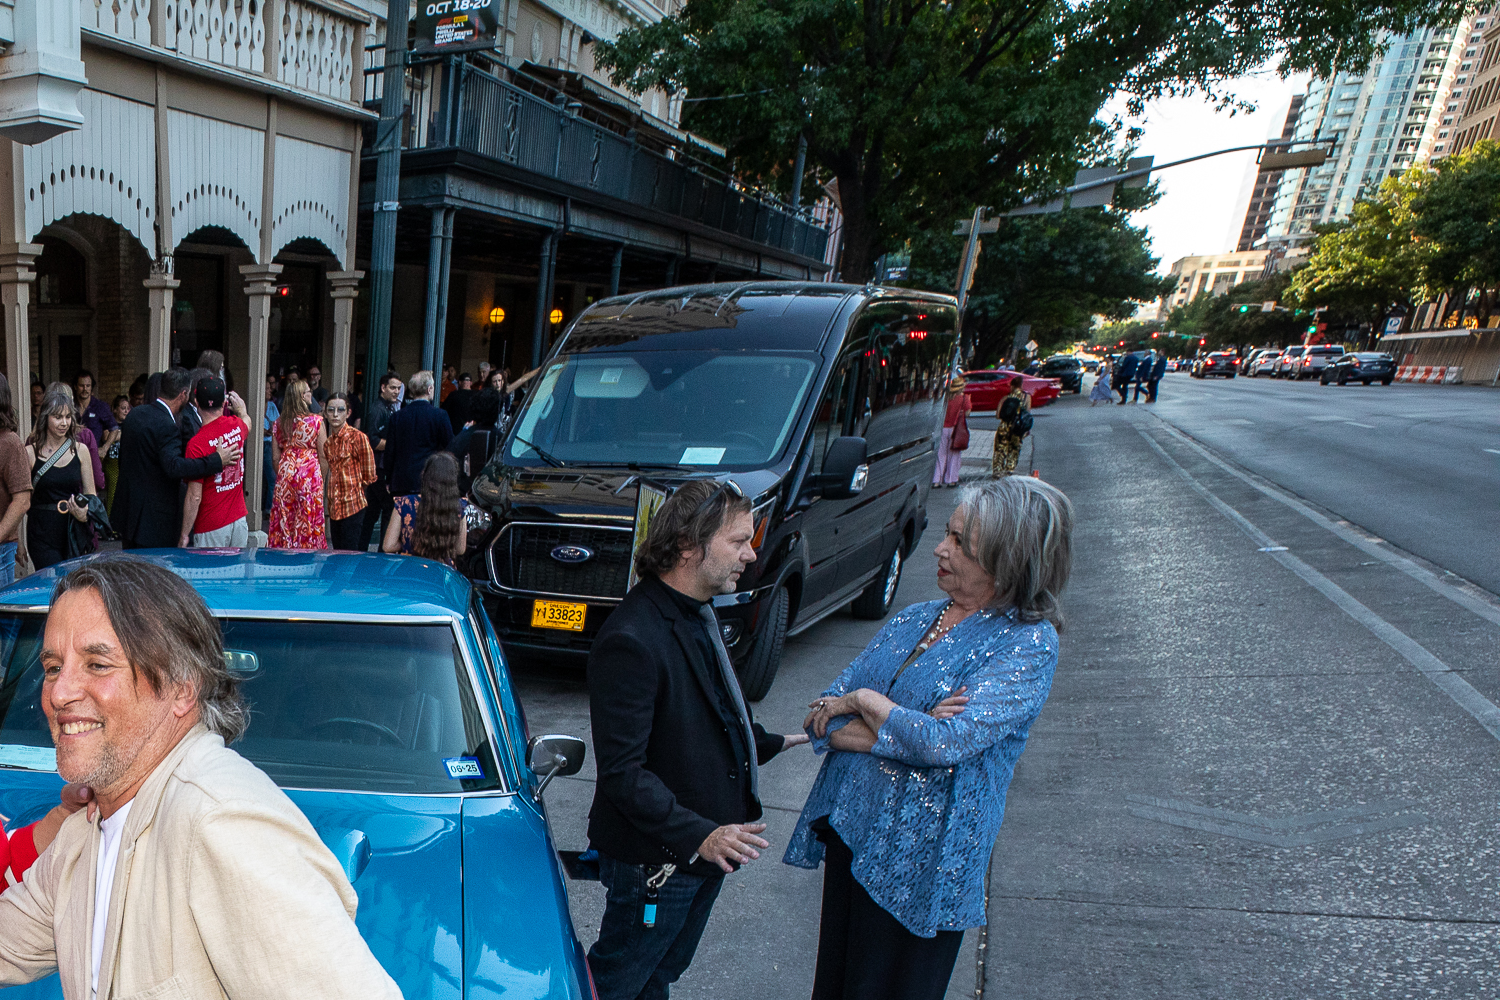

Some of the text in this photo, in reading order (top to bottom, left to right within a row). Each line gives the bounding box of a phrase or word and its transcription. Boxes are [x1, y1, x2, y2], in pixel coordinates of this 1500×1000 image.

[426, 0, 492, 16] OCT 18-20
[536, 607, 583, 622] Y133823
